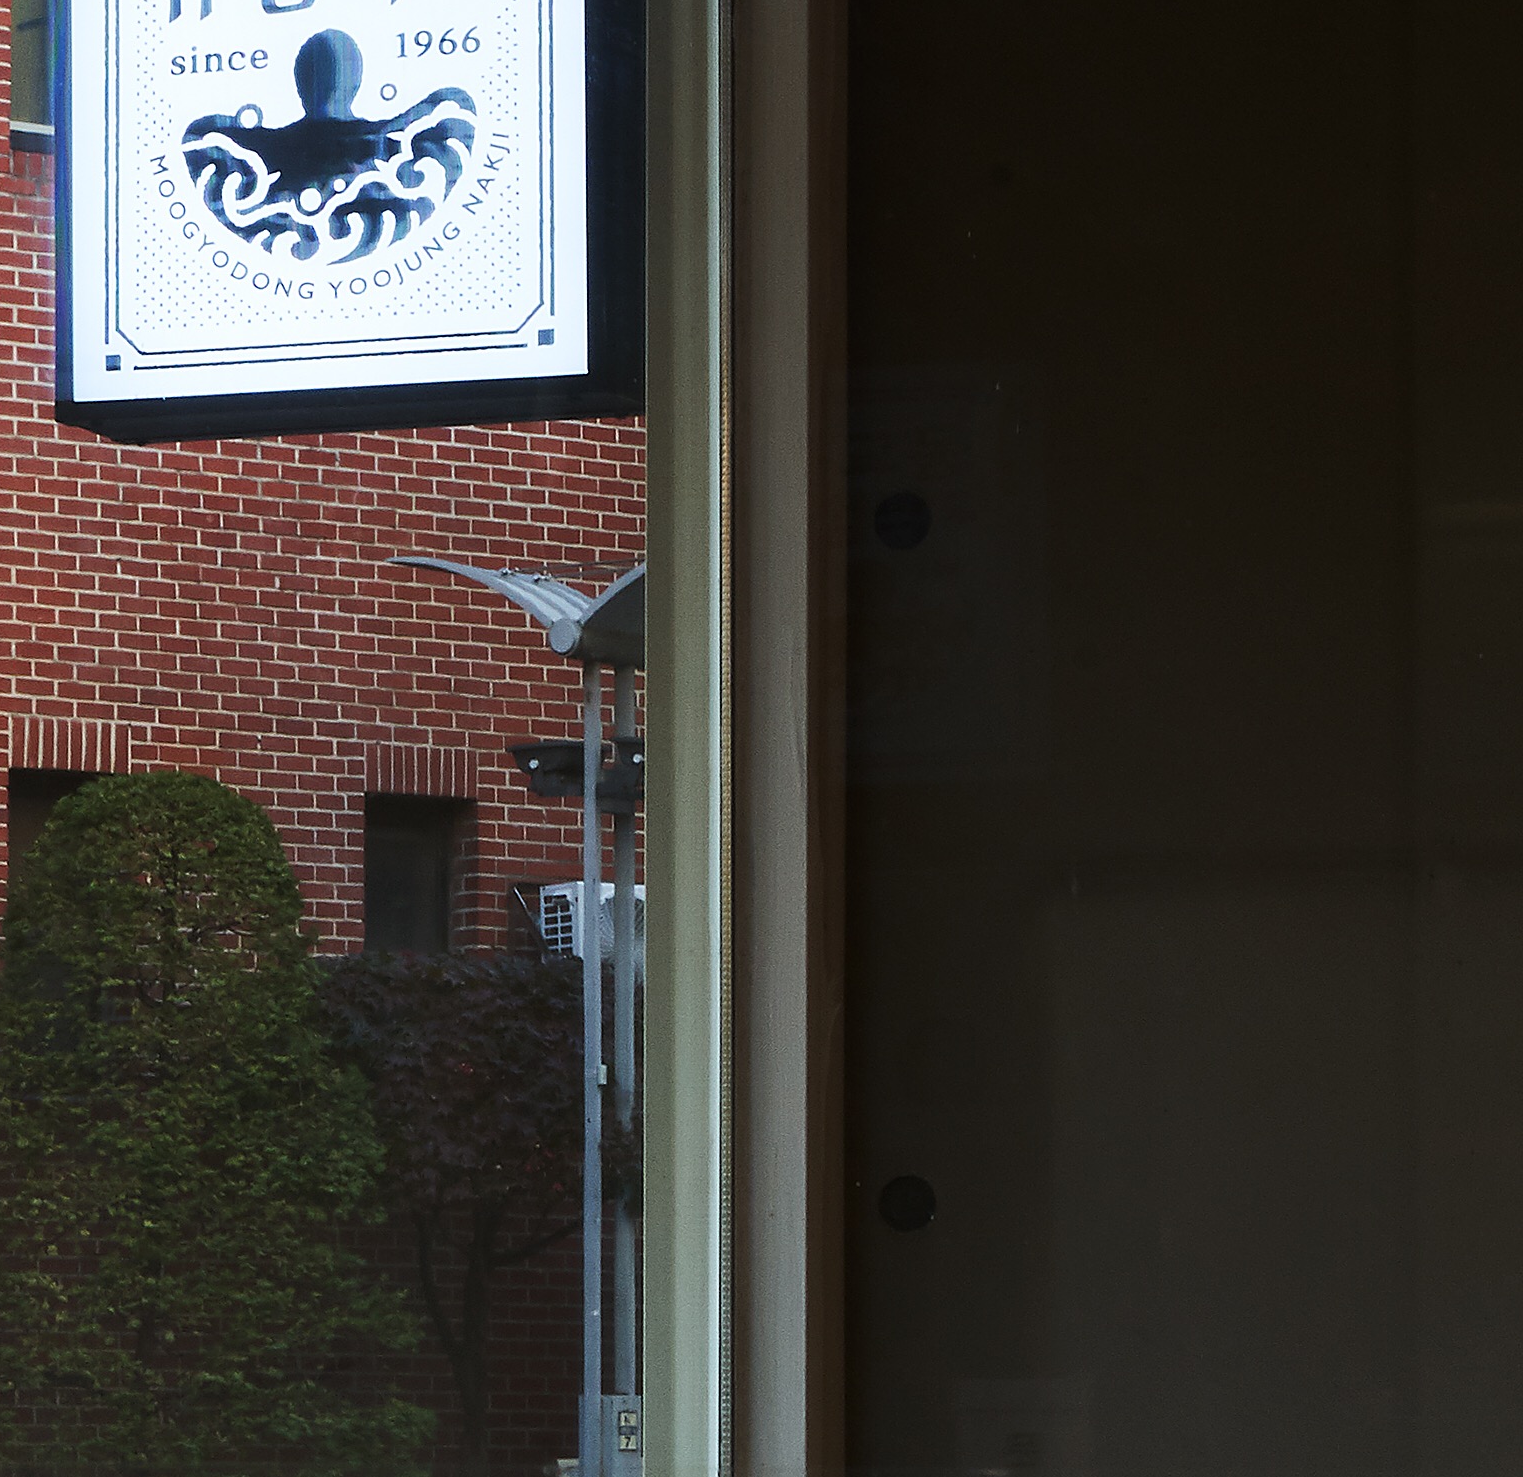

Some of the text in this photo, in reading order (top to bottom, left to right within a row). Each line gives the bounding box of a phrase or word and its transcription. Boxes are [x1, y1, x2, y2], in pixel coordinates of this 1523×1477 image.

[169, 26, 482, 77] since 1966
[150, 132, 510, 301] MOOGYODONG YOOJUNG NAKJI
